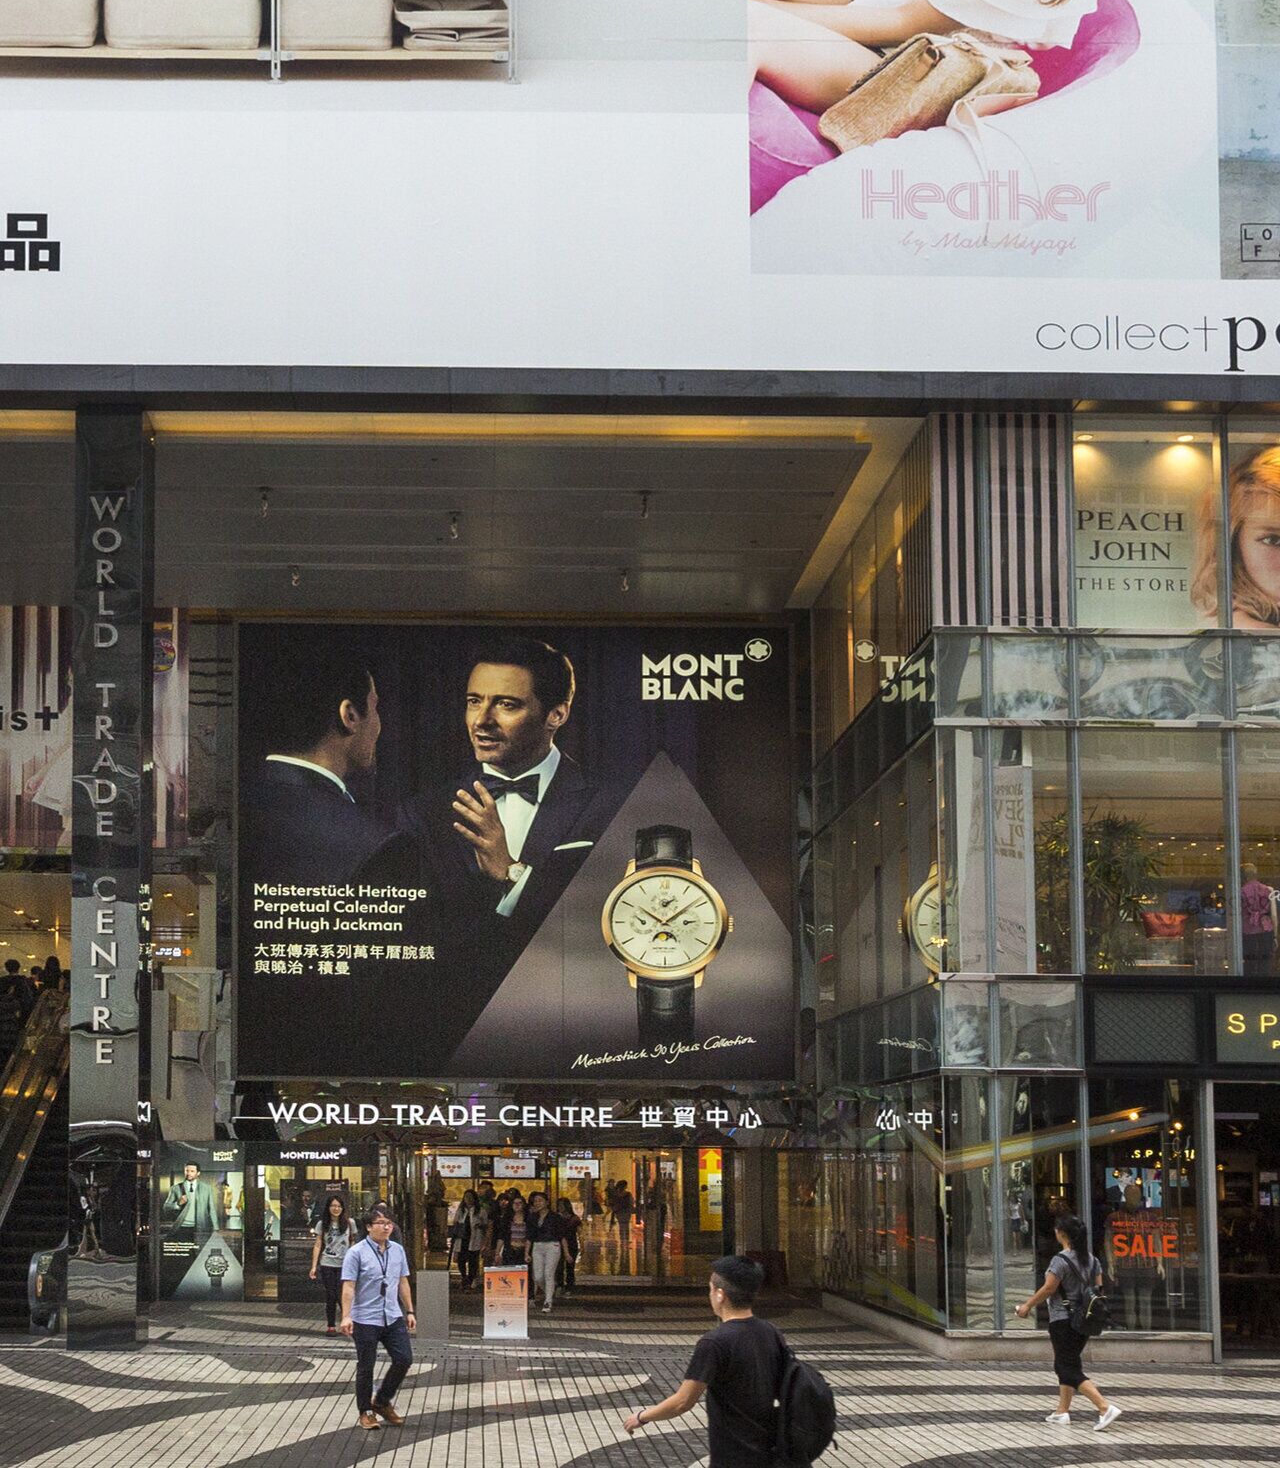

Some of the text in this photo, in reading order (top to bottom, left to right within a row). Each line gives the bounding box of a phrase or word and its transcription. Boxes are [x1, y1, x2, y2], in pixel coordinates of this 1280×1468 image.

[860, 168, 1112, 223] Heather
[1077, 509, 1184, 532] PEACH
[1088, 539, 1172, 562] JOHN
[89, 494, 126, 649] WORLD
[1075, 577, 1188, 592] THE STORE
[641, 653, 744, 677] MONT
[641, 677, 744, 702] BLANC
[93, 682, 120, 838] TRADE
[253, 882, 428, 902] Meisterstück Heritage
[253, 898, 406, 915] Perpetual Calendar
[253, 916, 404, 934] and Hugh Jackman
[89, 876, 120, 1066] CENTRE
[267, 1101, 763, 1130] WORLD TRADE CENTRE 世貿中心
[280, 1151, 340, 1160] MONTBLANC
[1112, 1233, 1180, 1258] SALE
